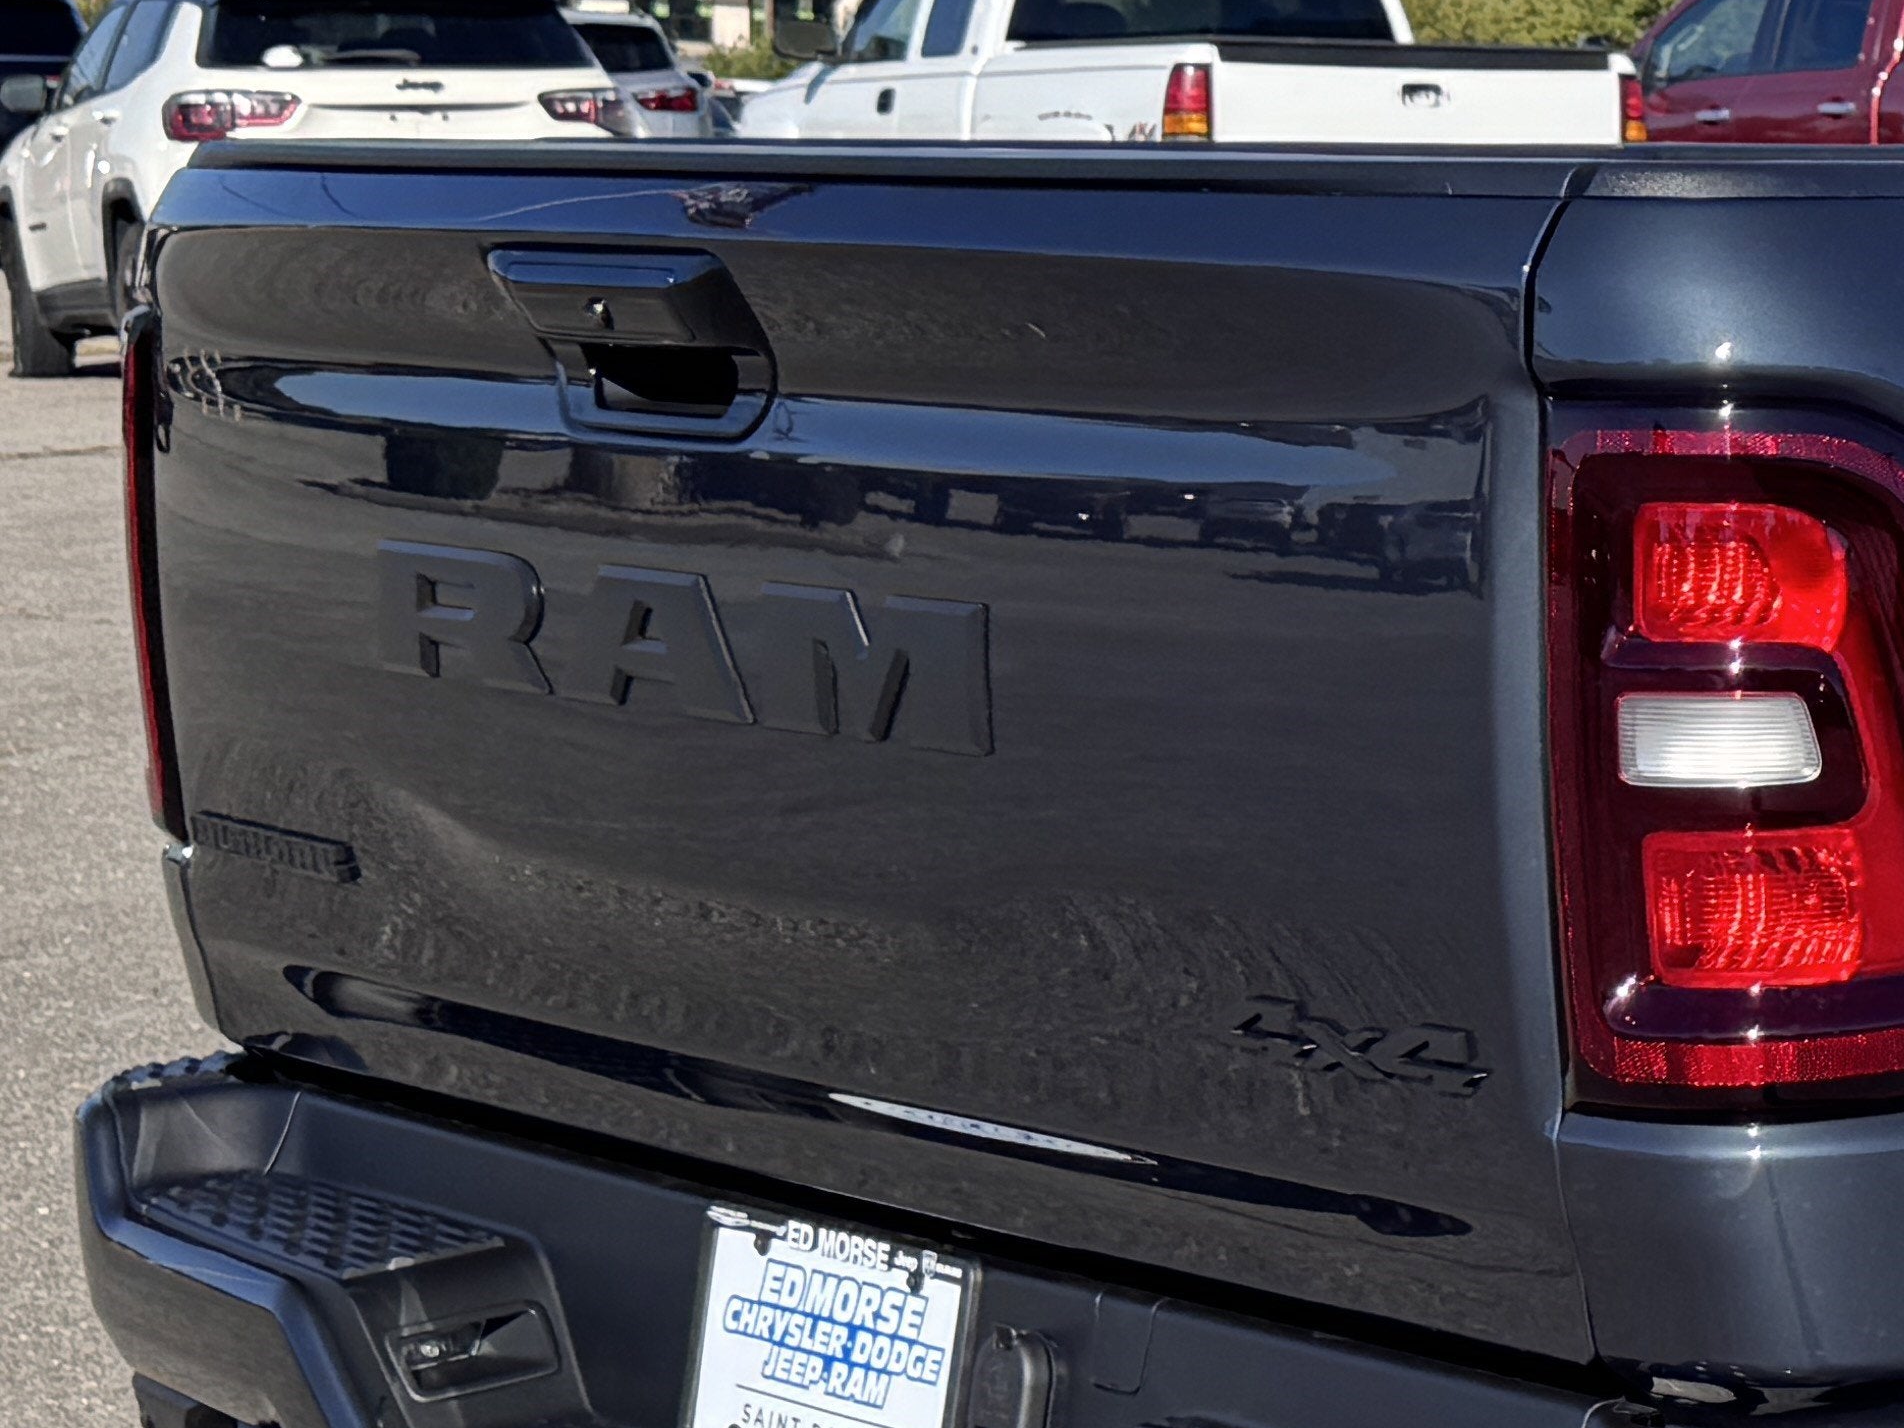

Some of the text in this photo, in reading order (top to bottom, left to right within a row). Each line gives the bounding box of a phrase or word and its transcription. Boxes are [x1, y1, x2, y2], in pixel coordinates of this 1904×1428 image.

[376, 538, 997, 758] RAM
[787, 1219, 814, 1251] ED
[817, 1227, 891, 1271] MORSE
[760, 1259, 929, 1339] ED MORSE
